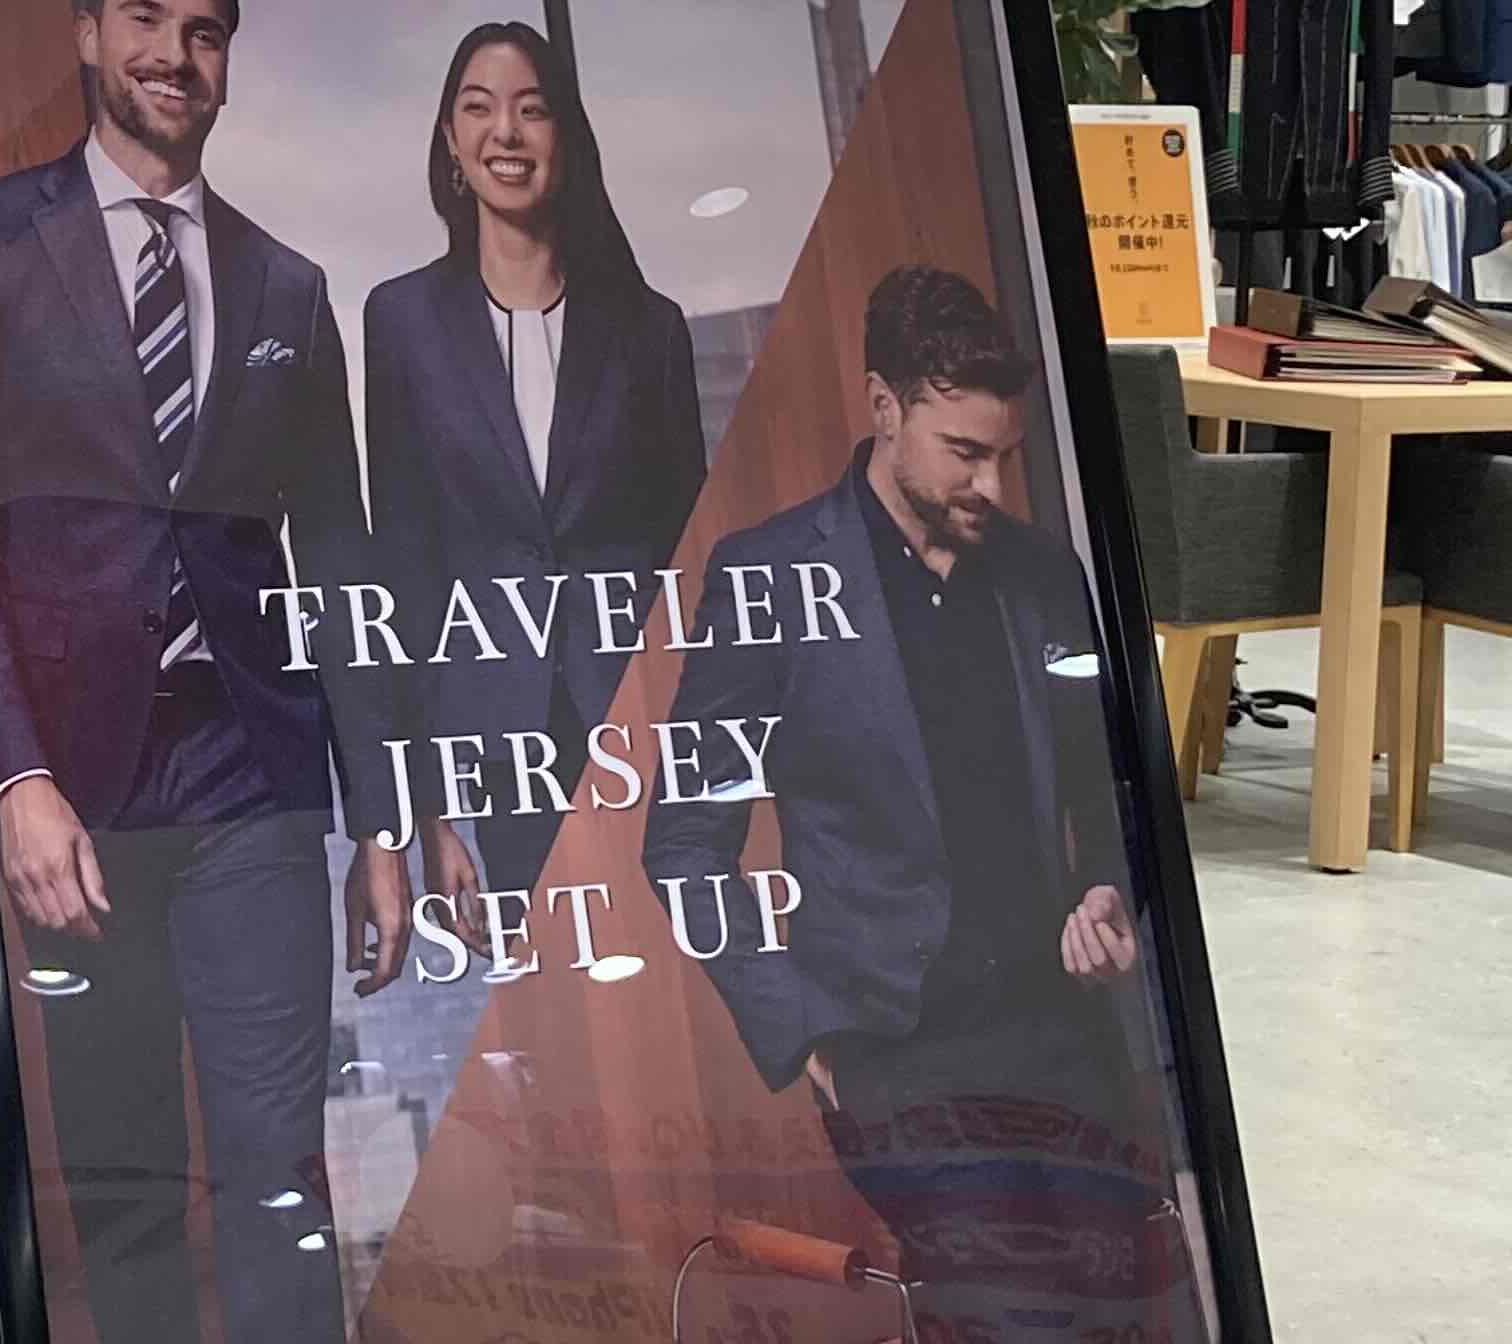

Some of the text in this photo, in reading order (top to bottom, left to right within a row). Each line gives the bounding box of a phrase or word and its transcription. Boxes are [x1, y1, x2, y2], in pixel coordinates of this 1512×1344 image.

[259, 562, 861, 672] TRAVELER
[376, 716, 782, 850] JERSEY
[412, 870, 802, 983] SET UP
